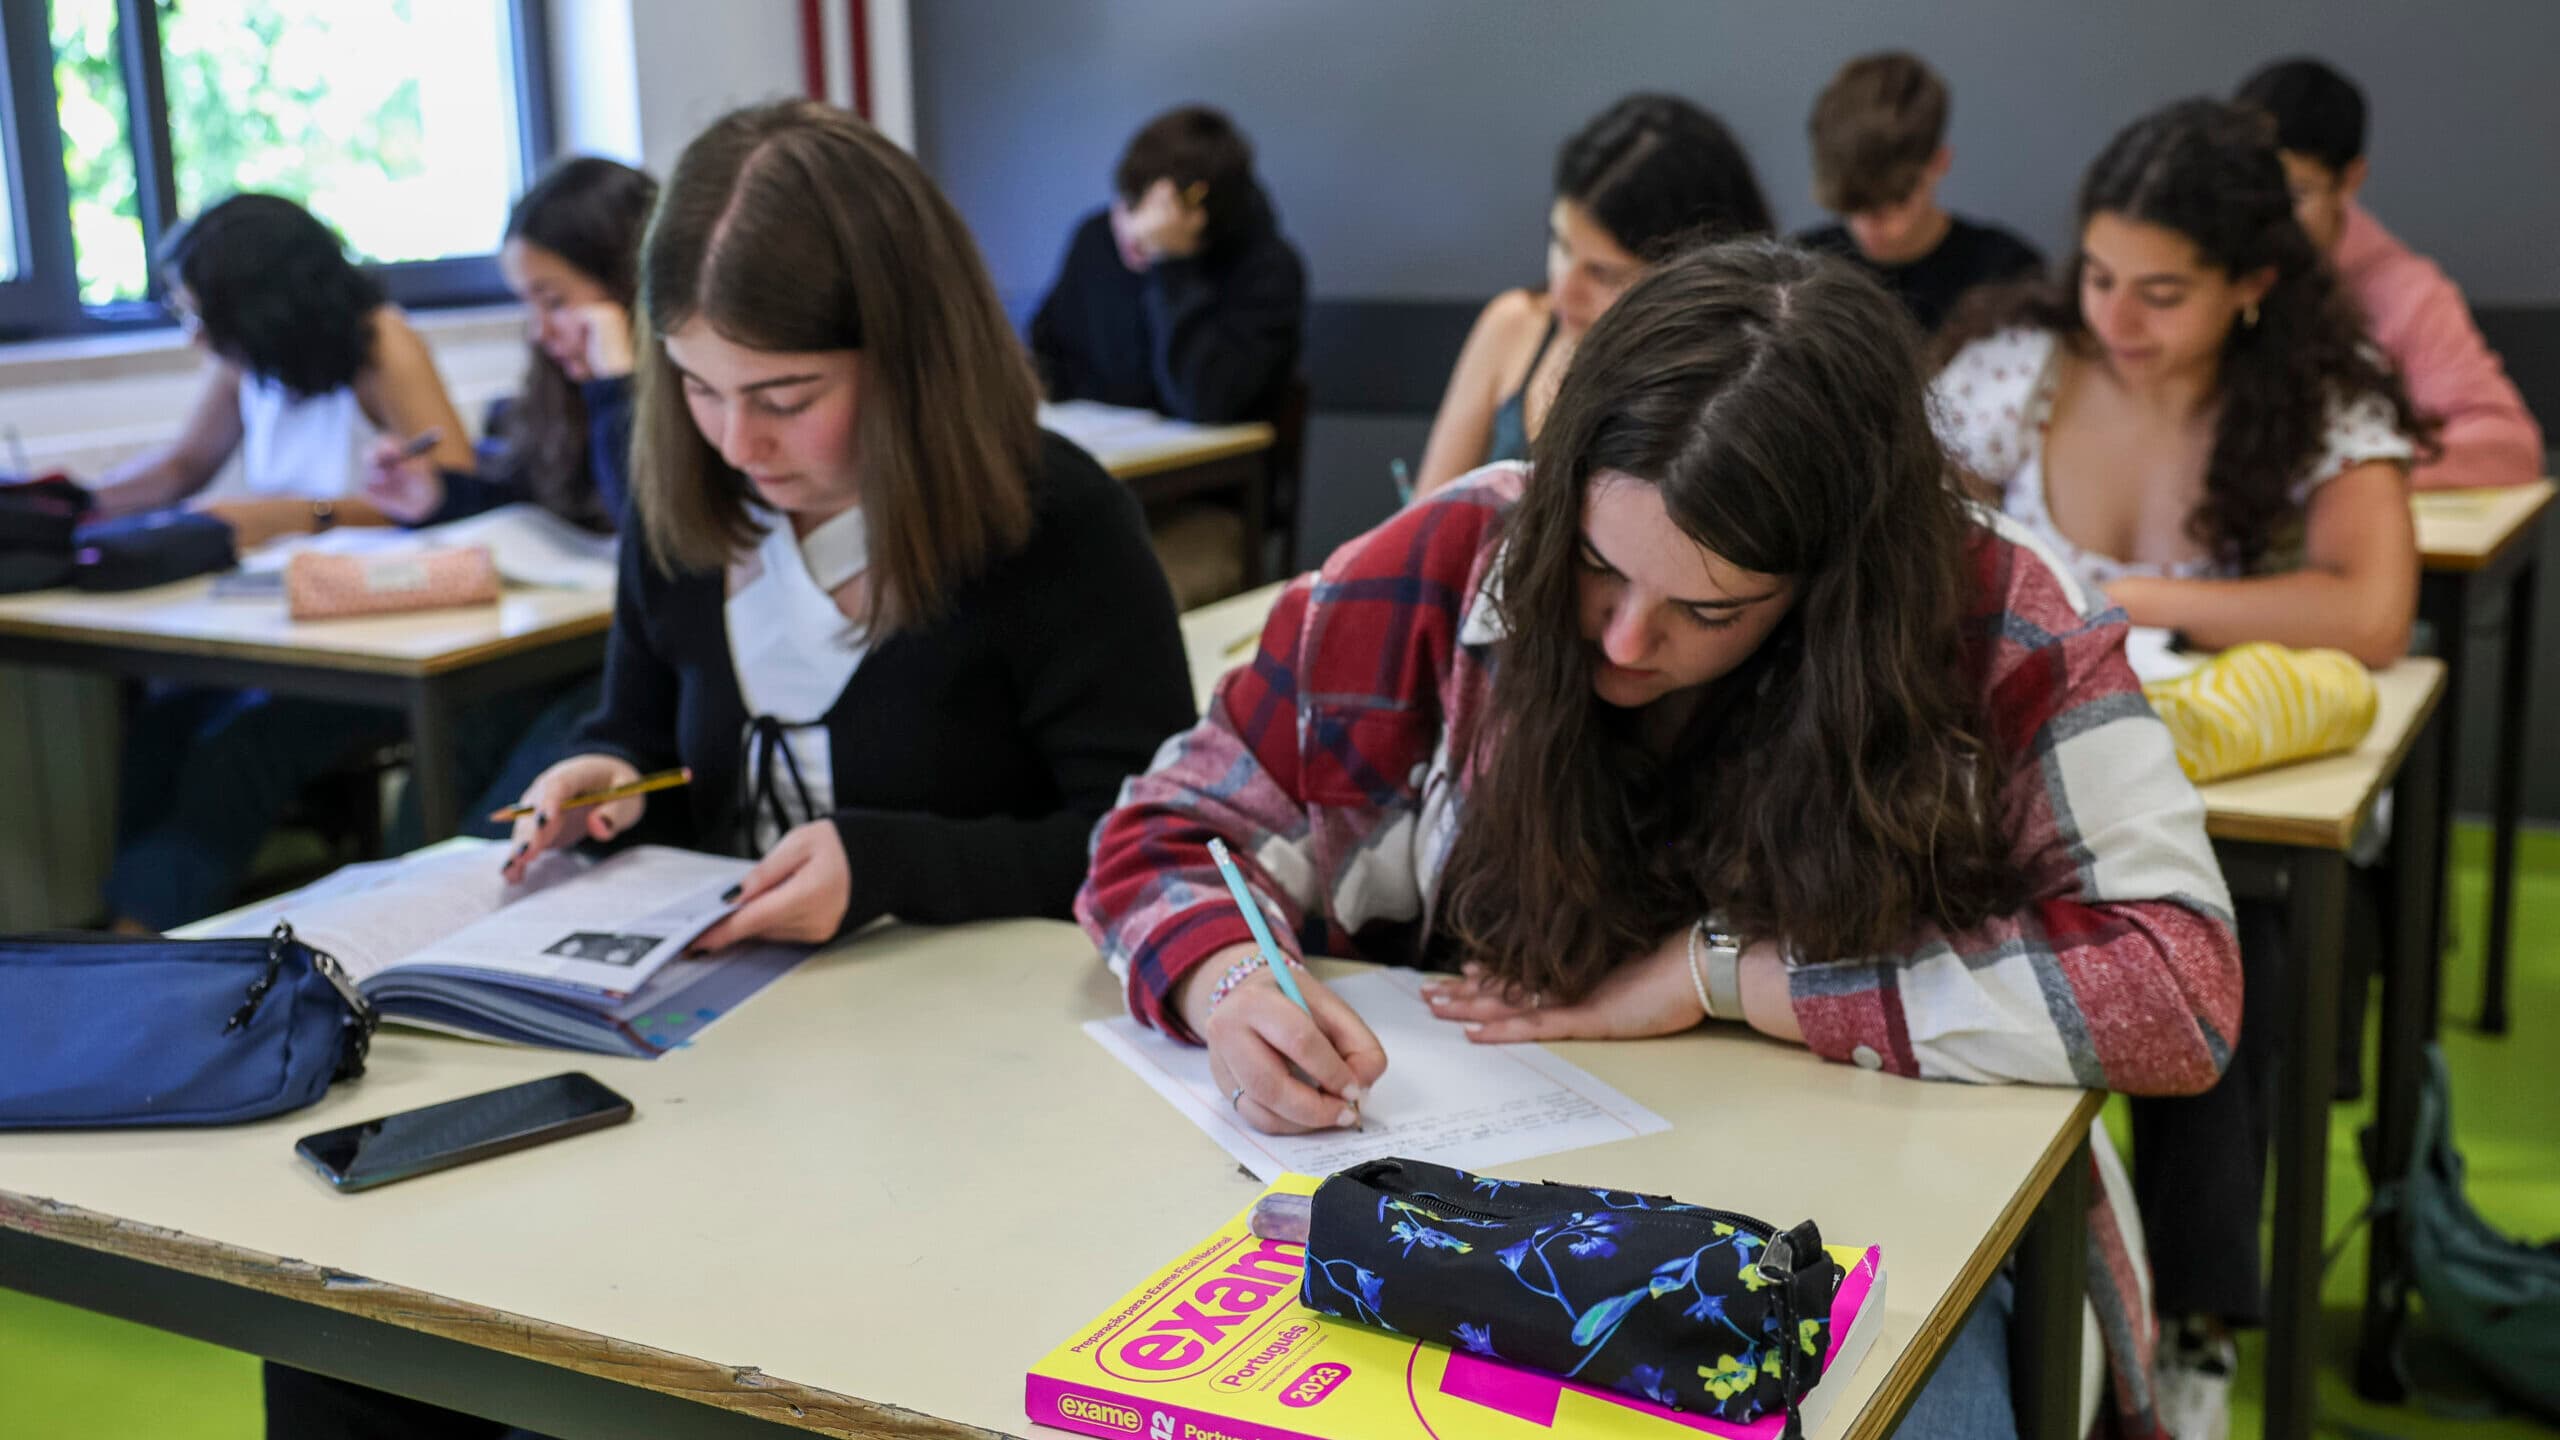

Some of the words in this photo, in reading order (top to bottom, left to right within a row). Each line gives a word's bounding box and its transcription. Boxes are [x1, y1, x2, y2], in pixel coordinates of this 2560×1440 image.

[1070, 1314, 1127, 1353] Preparação
[1123, 1298, 1146, 1317] para
[1146, 1272, 1180, 1296] Exame
[1173, 1258, 1200, 1274] Final
[1120, 1238, 1307, 1371] exam
[1220, 1325, 1309, 1387] Português
[1289, 1367, 1342, 1403] 2023
[1062, 1398, 1138, 1429] exame
[1150, 1410, 1175, 1440] 12
